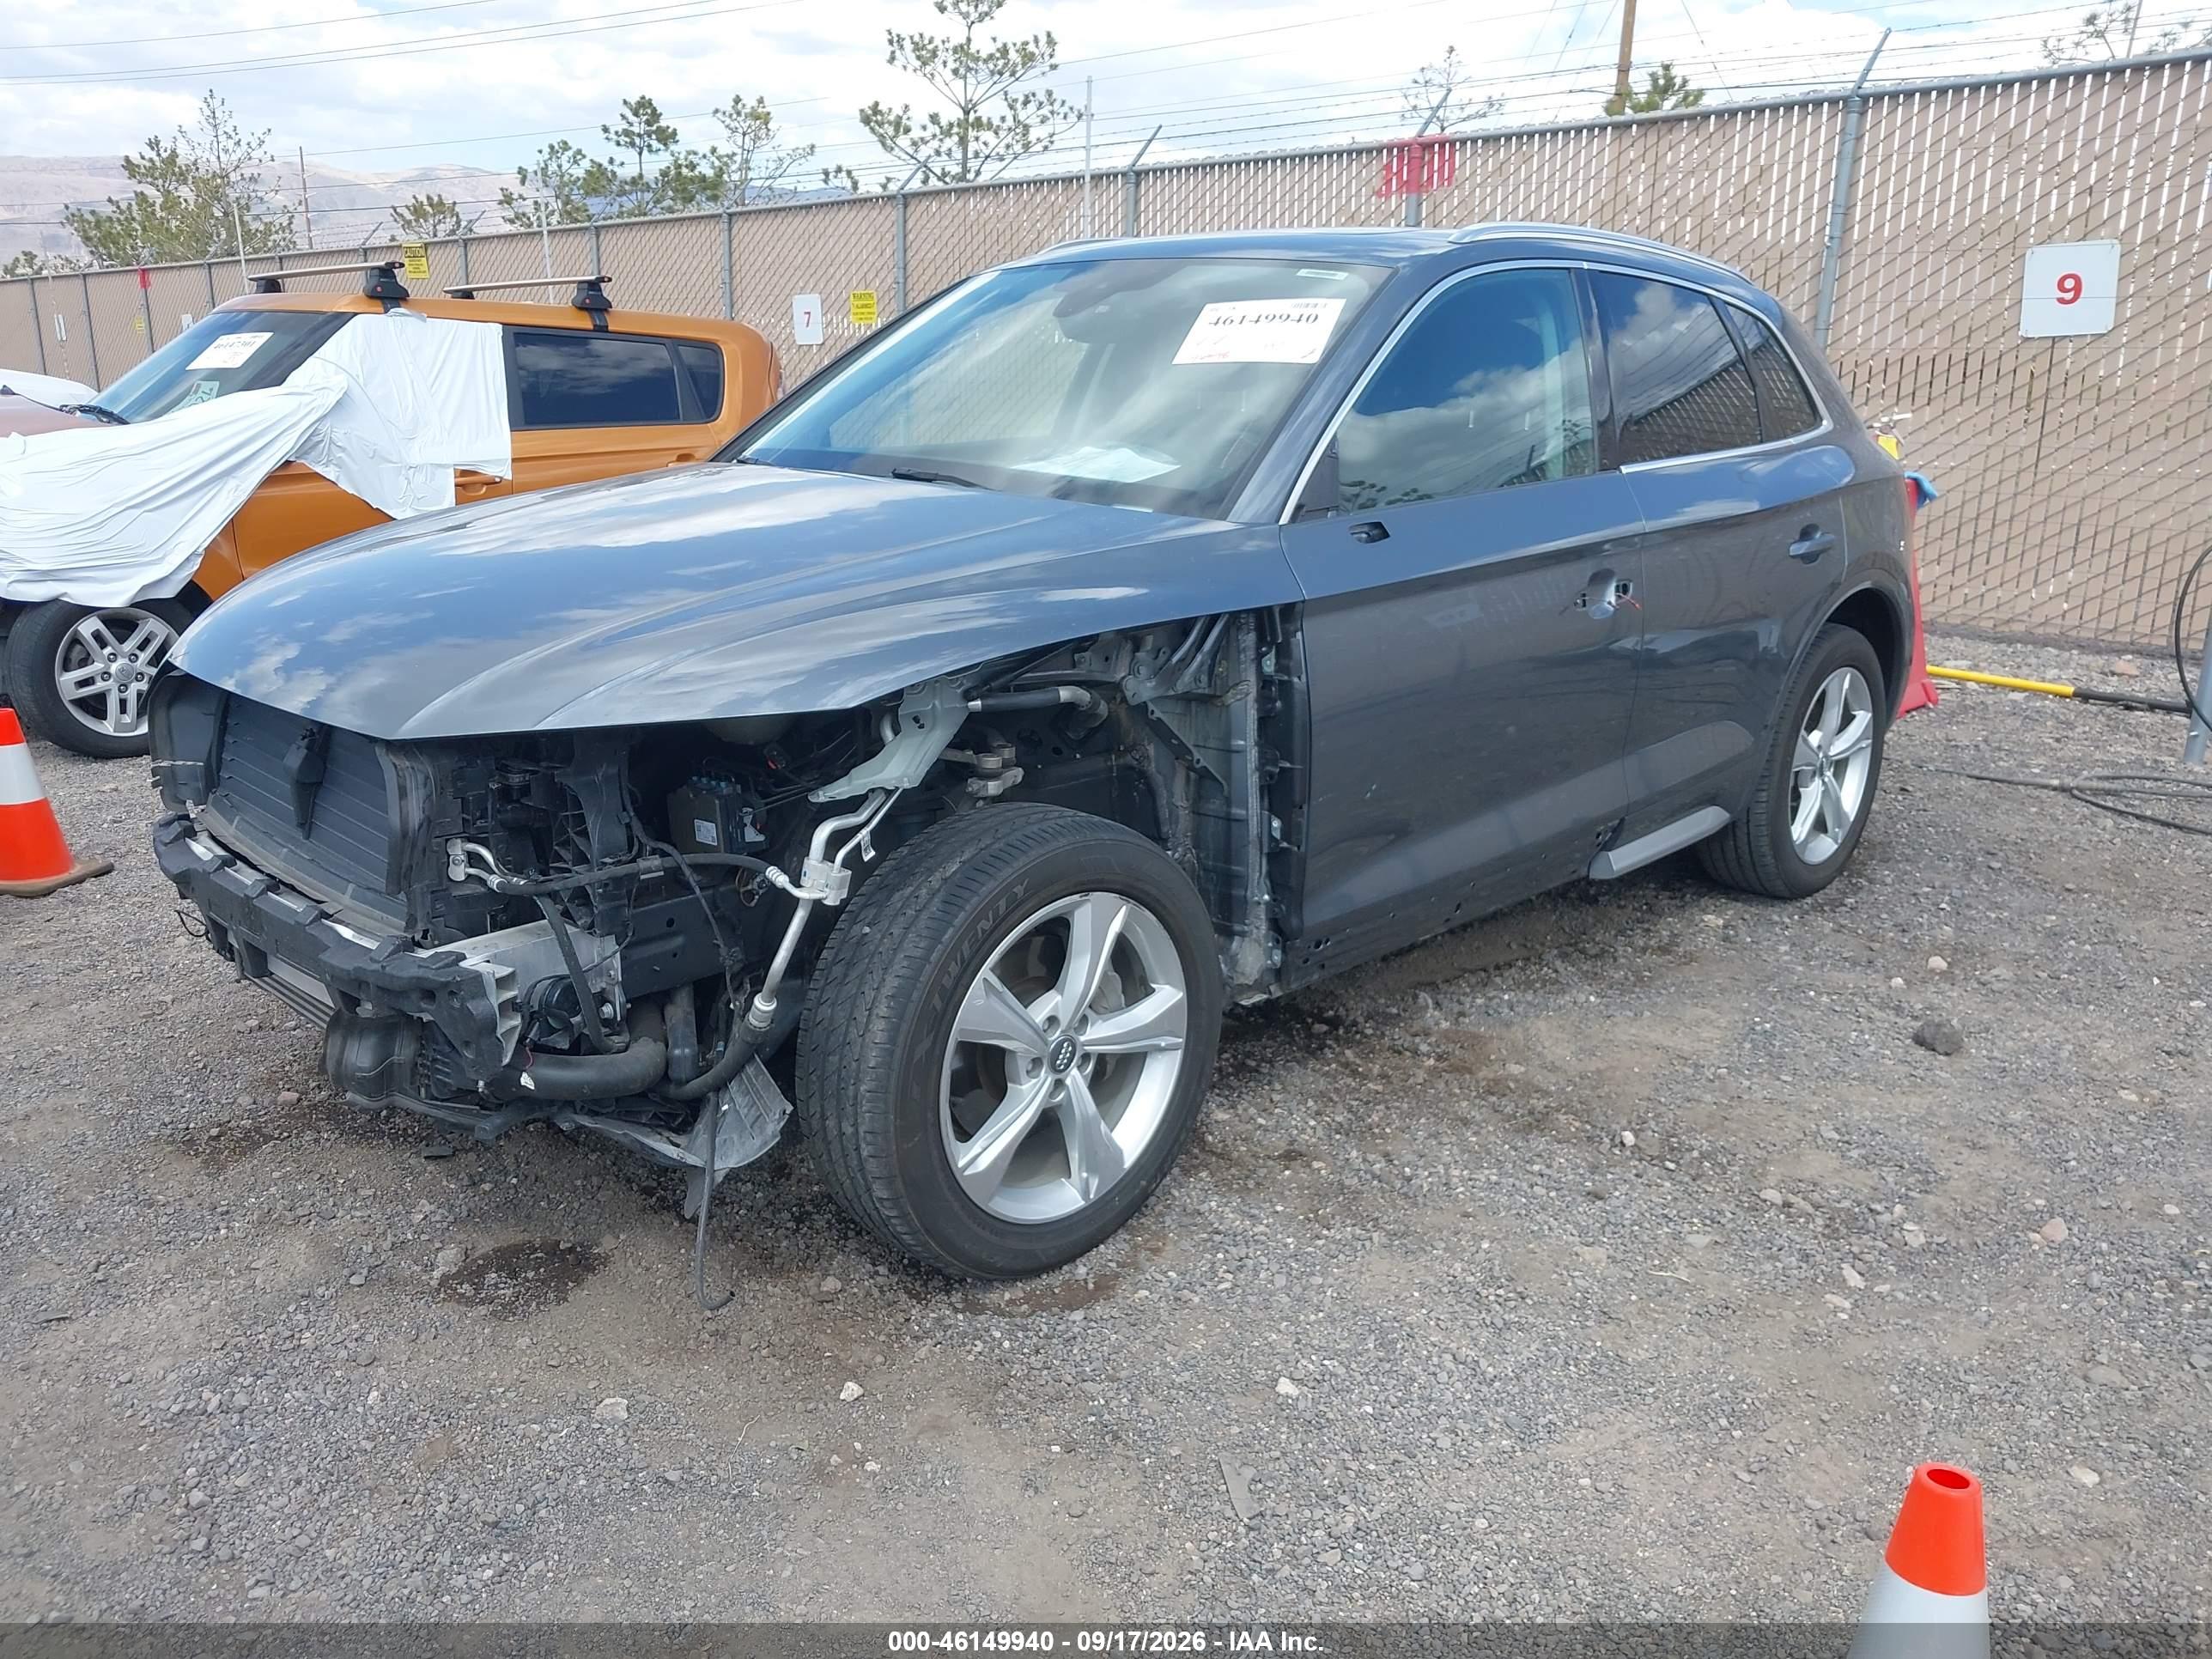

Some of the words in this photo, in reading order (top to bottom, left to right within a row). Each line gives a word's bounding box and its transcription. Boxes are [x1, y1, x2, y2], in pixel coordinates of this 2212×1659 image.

[2056, 273, 2082, 305] 9
[803, 311, 811, 328] 7
[1208, 313, 1319, 326] 46149940
[926, 878, 1030, 1013] TWENTY
